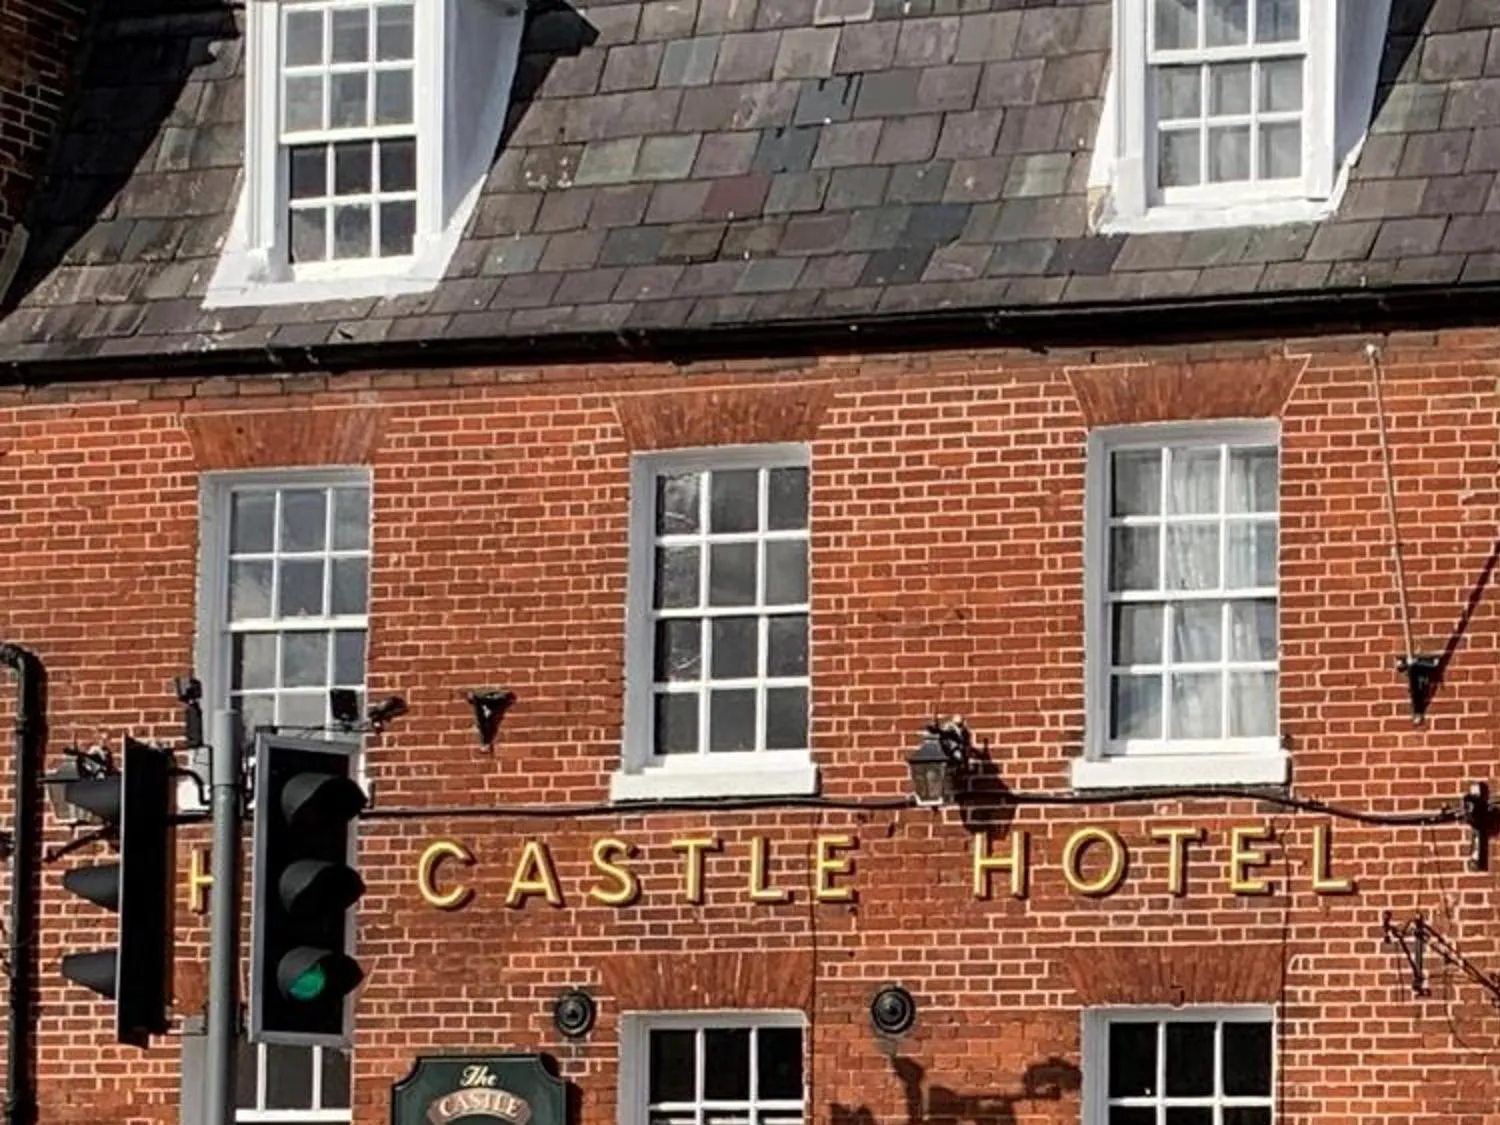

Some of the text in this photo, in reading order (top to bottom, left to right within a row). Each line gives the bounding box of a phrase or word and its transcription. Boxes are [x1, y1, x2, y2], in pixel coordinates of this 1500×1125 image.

[417, 823, 1354, 908] CASTLE HOTEL
[459, 1064, 497, 1087] The
[439, 1091, 521, 1118] CASTLE
